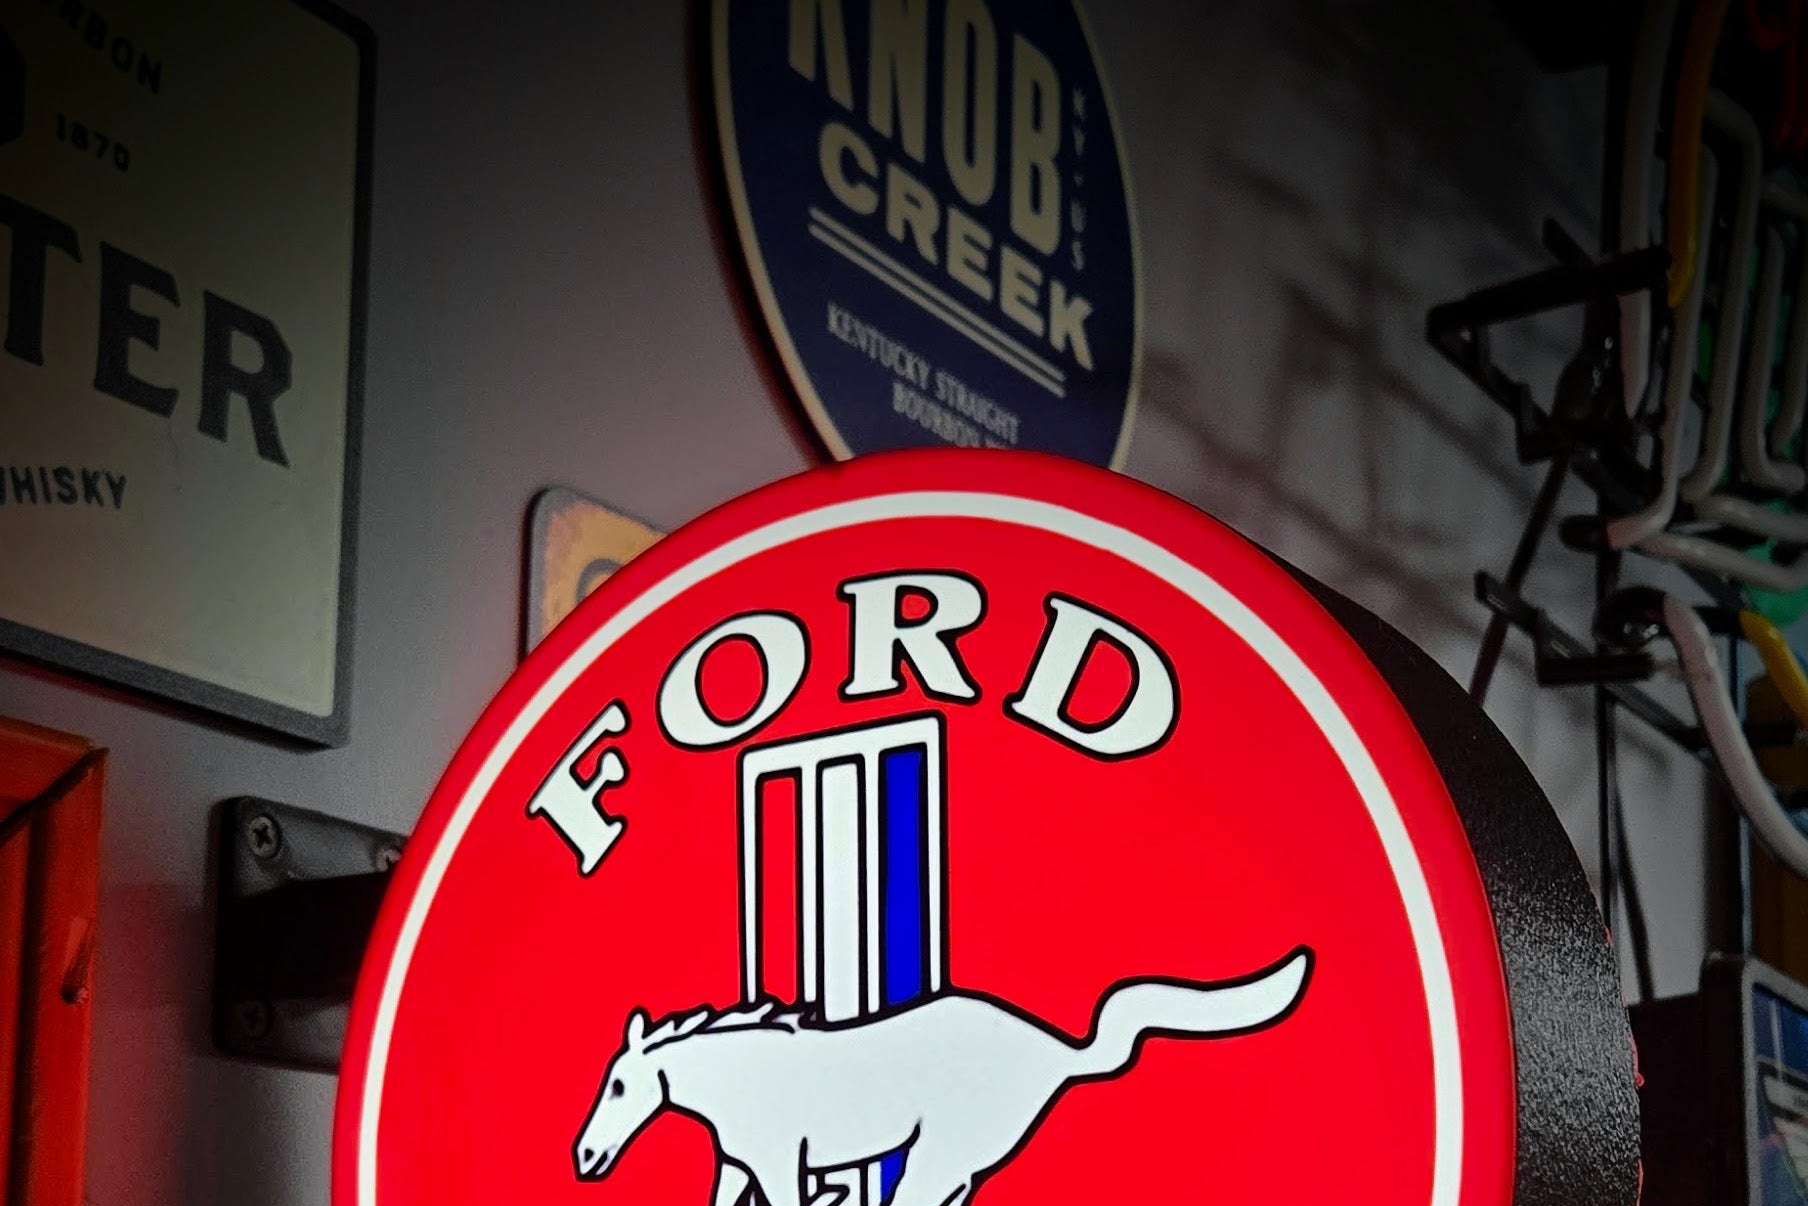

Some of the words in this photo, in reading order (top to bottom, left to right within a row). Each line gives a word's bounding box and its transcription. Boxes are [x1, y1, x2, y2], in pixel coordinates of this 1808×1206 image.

[40, 0, 161, 94] RBON
[56, 112, 130, 172] 1870
[818, 119, 1095, 373] CREEK
[827, 301, 931, 390] KENTUCKY
[934, 367, 1021, 446] STRAIGHT
[0, 465, 128, 509] HISKY
[525, 568, 1182, 876] FORD
